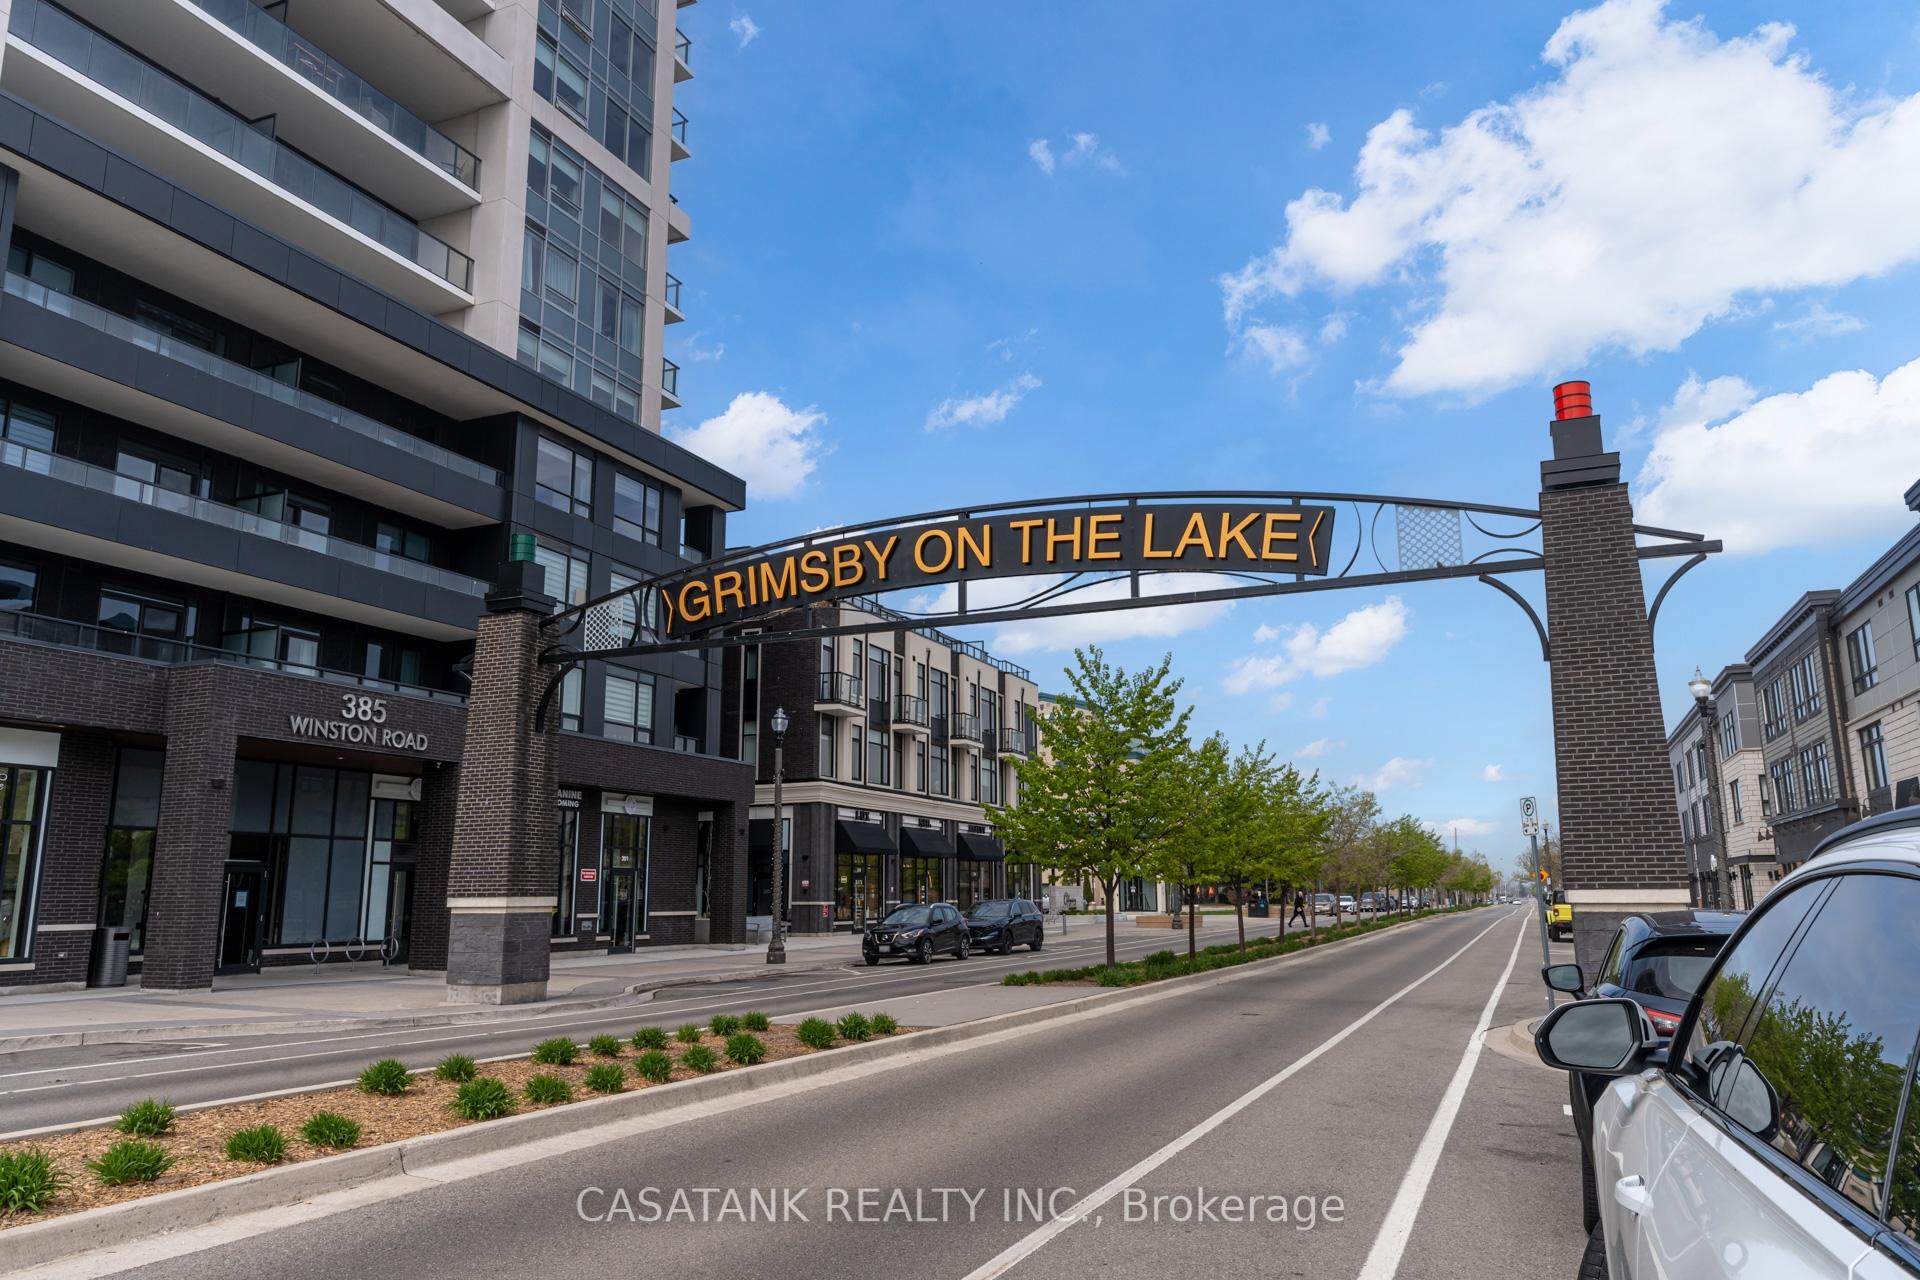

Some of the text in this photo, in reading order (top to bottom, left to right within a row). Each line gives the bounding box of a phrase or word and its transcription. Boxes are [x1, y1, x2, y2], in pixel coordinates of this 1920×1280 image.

[678, 512, 1302, 622] GRIMSBY ON THE LAKE
[341, 693, 388, 724] 385
[290, 715, 428, 751] WINSTON ROAD
